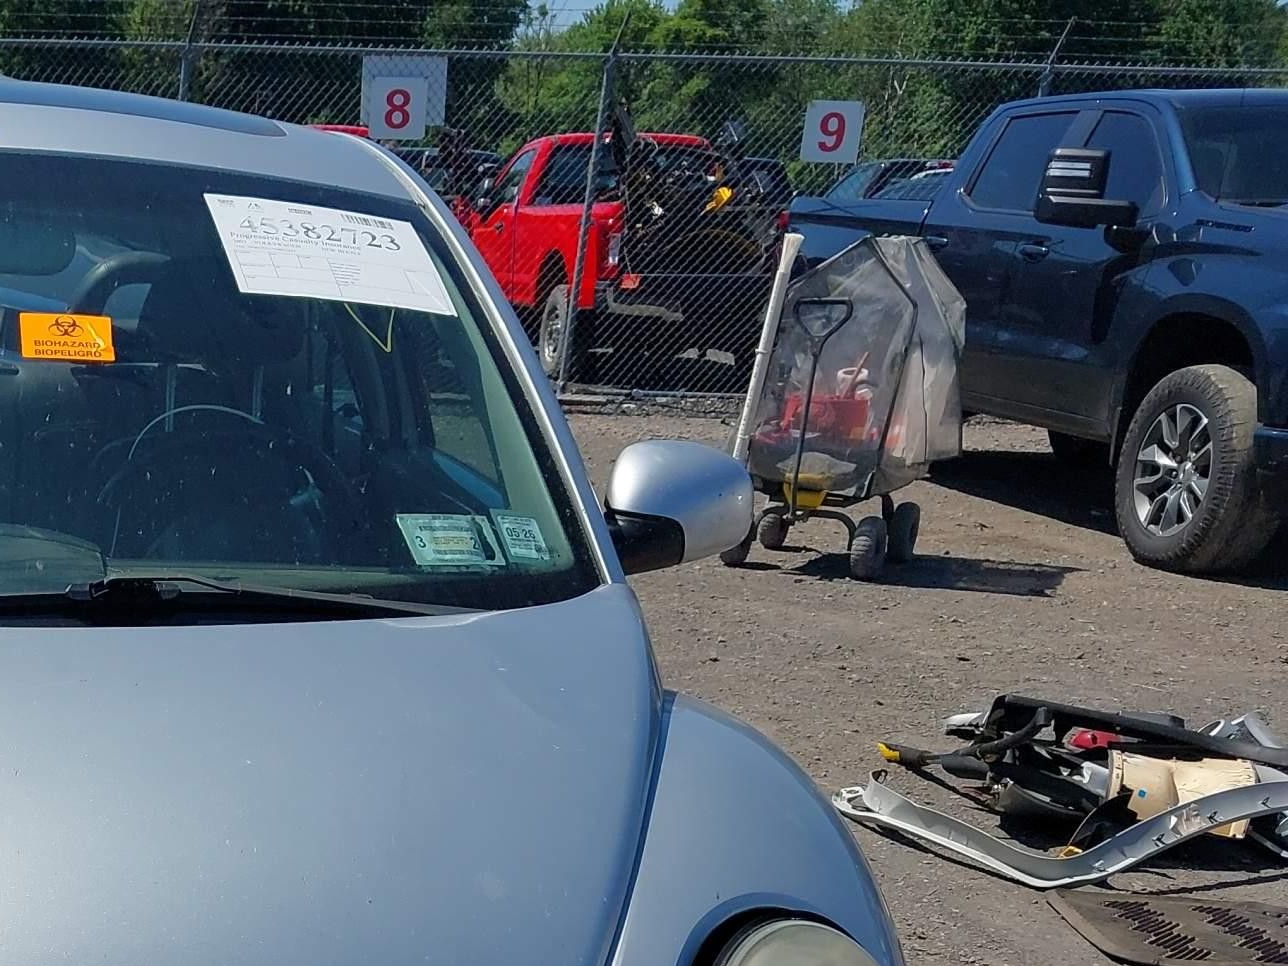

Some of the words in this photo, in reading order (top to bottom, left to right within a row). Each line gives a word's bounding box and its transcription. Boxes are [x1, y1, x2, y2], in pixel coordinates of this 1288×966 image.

[385, 89, 411, 129] 8
[818, 111, 845, 152] 9
[240, 215, 401, 251] 45382723
[34, 339, 101, 348] BIOHAZARD
[34, 348, 102, 358] BIOPELIGRO
[415, 535, 427, 549] 3
